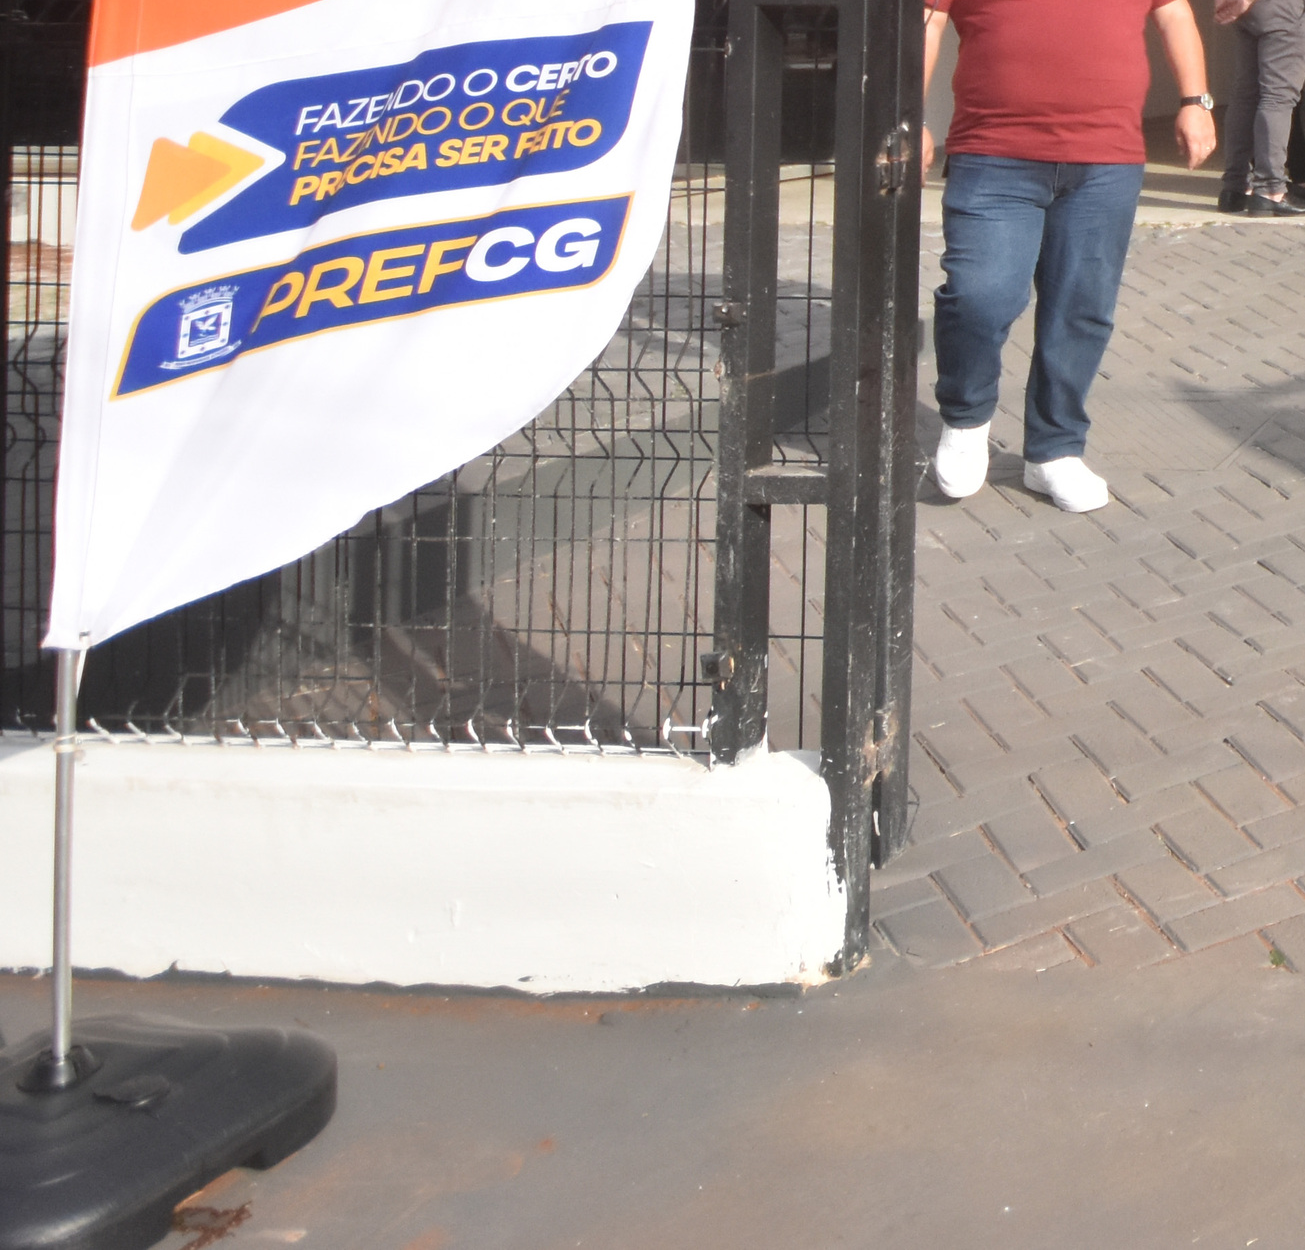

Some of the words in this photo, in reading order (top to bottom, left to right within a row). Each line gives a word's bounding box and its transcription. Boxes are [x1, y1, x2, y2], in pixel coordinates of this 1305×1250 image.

[293, 106, 452, 171] FAZENDO
[458, 102, 495, 130] O
[501, 89, 571, 126] QUE
[295, 73, 456, 135] FAZENDO
[463, 68, 498, 97] O
[505, 51, 618, 92] CERTO
[435, 134, 509, 168] SER
[513, 118, 602, 159] FEITO
[250, 217, 603, 334] PREFCG
